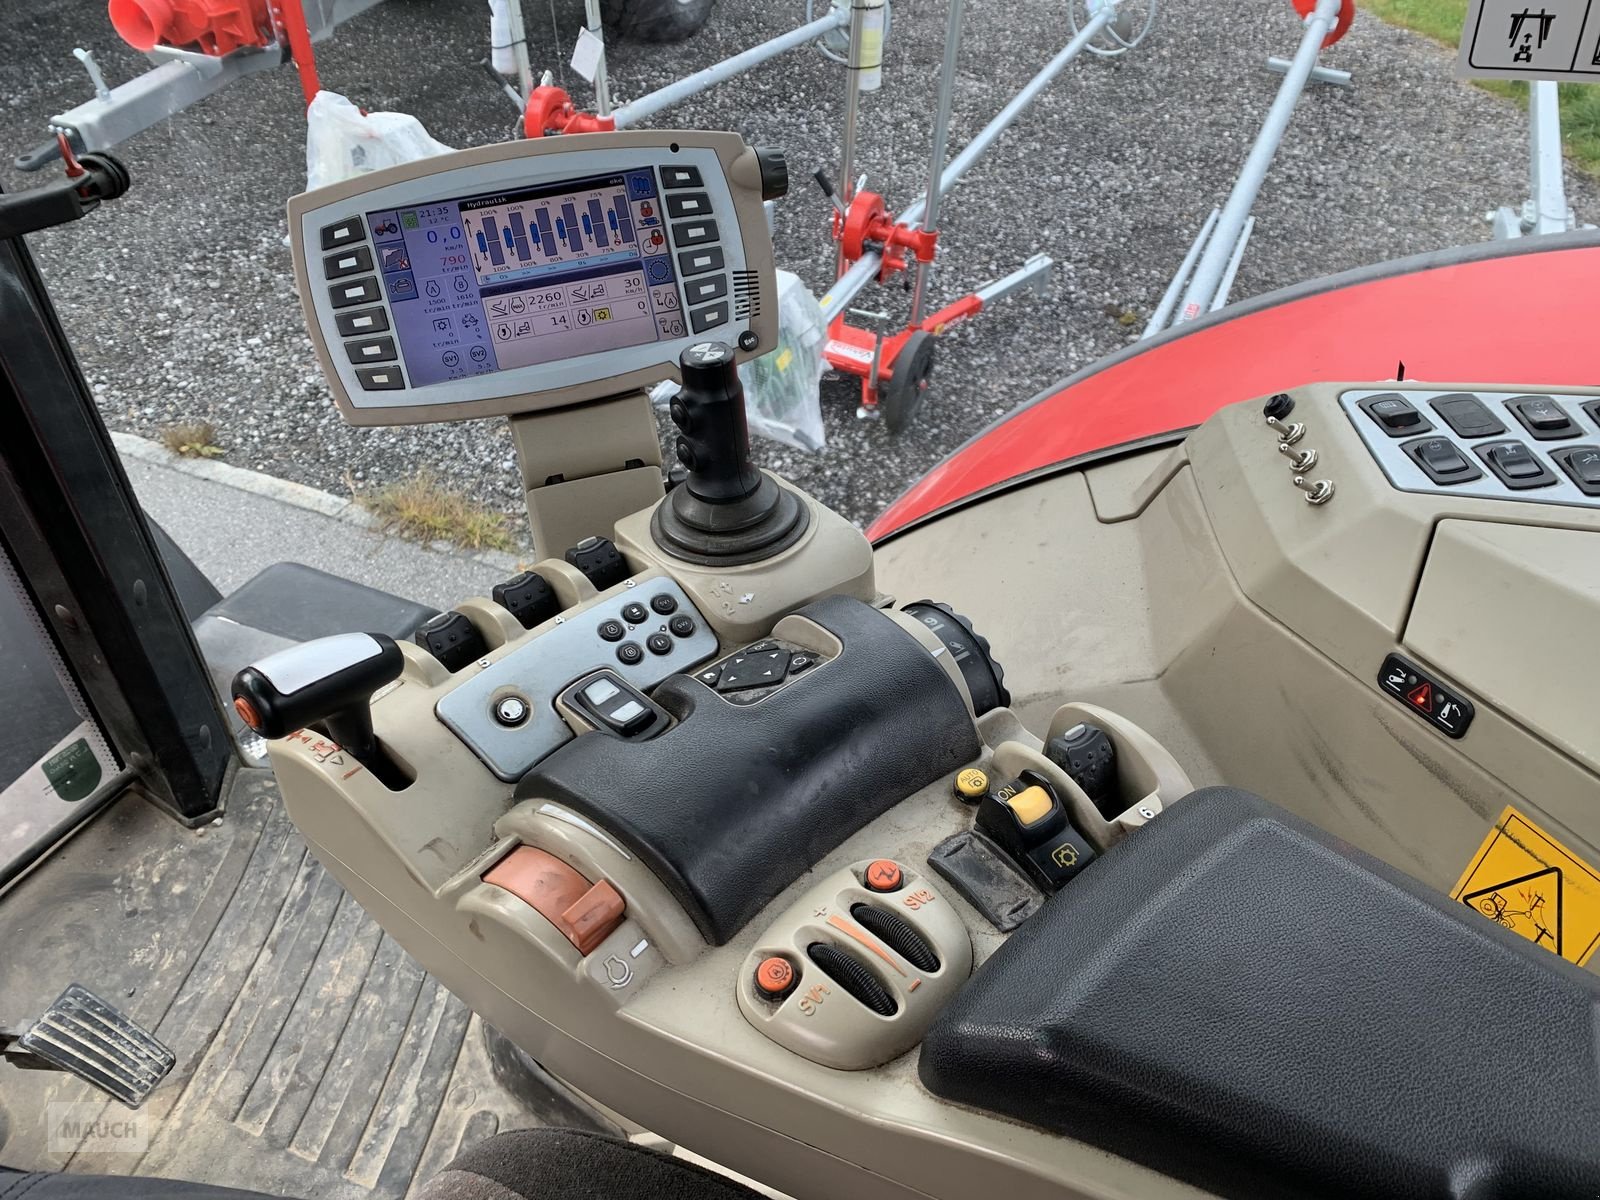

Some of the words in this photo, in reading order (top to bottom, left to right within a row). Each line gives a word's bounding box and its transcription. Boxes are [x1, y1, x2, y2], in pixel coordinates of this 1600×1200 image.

[467, 197, 507, 209] Hydraulik
[420, 207, 448, 218] 21:35
[427, 227, 461, 243] 0,0
[440, 255, 465, 265] 790
[624, 278, 641, 288] 30
[528, 291, 562, 304] 2260
[424, 304, 450, 314] tr/min
[453, 300, 478, 308] tr/min
[538, 301, 564, 310] tr/min
[638, 301, 646, 310] 0
[552, 315, 567, 326] 14
[433, 339, 459, 348] tr/min
[744, 336, 755, 346] Esc
[624, 579, 636, 588] 3
[554, 615, 566, 624] 4
[754, 642, 768, 651] OK
[477, 658, 491, 669] 5
[960, 768, 978, 782] AUTO
[997, 785, 1016, 801] ON
[1138, 806, 1154, 819] 6
[902, 888, 936, 910] SV2
[798, 983, 831, 1017] SV1
